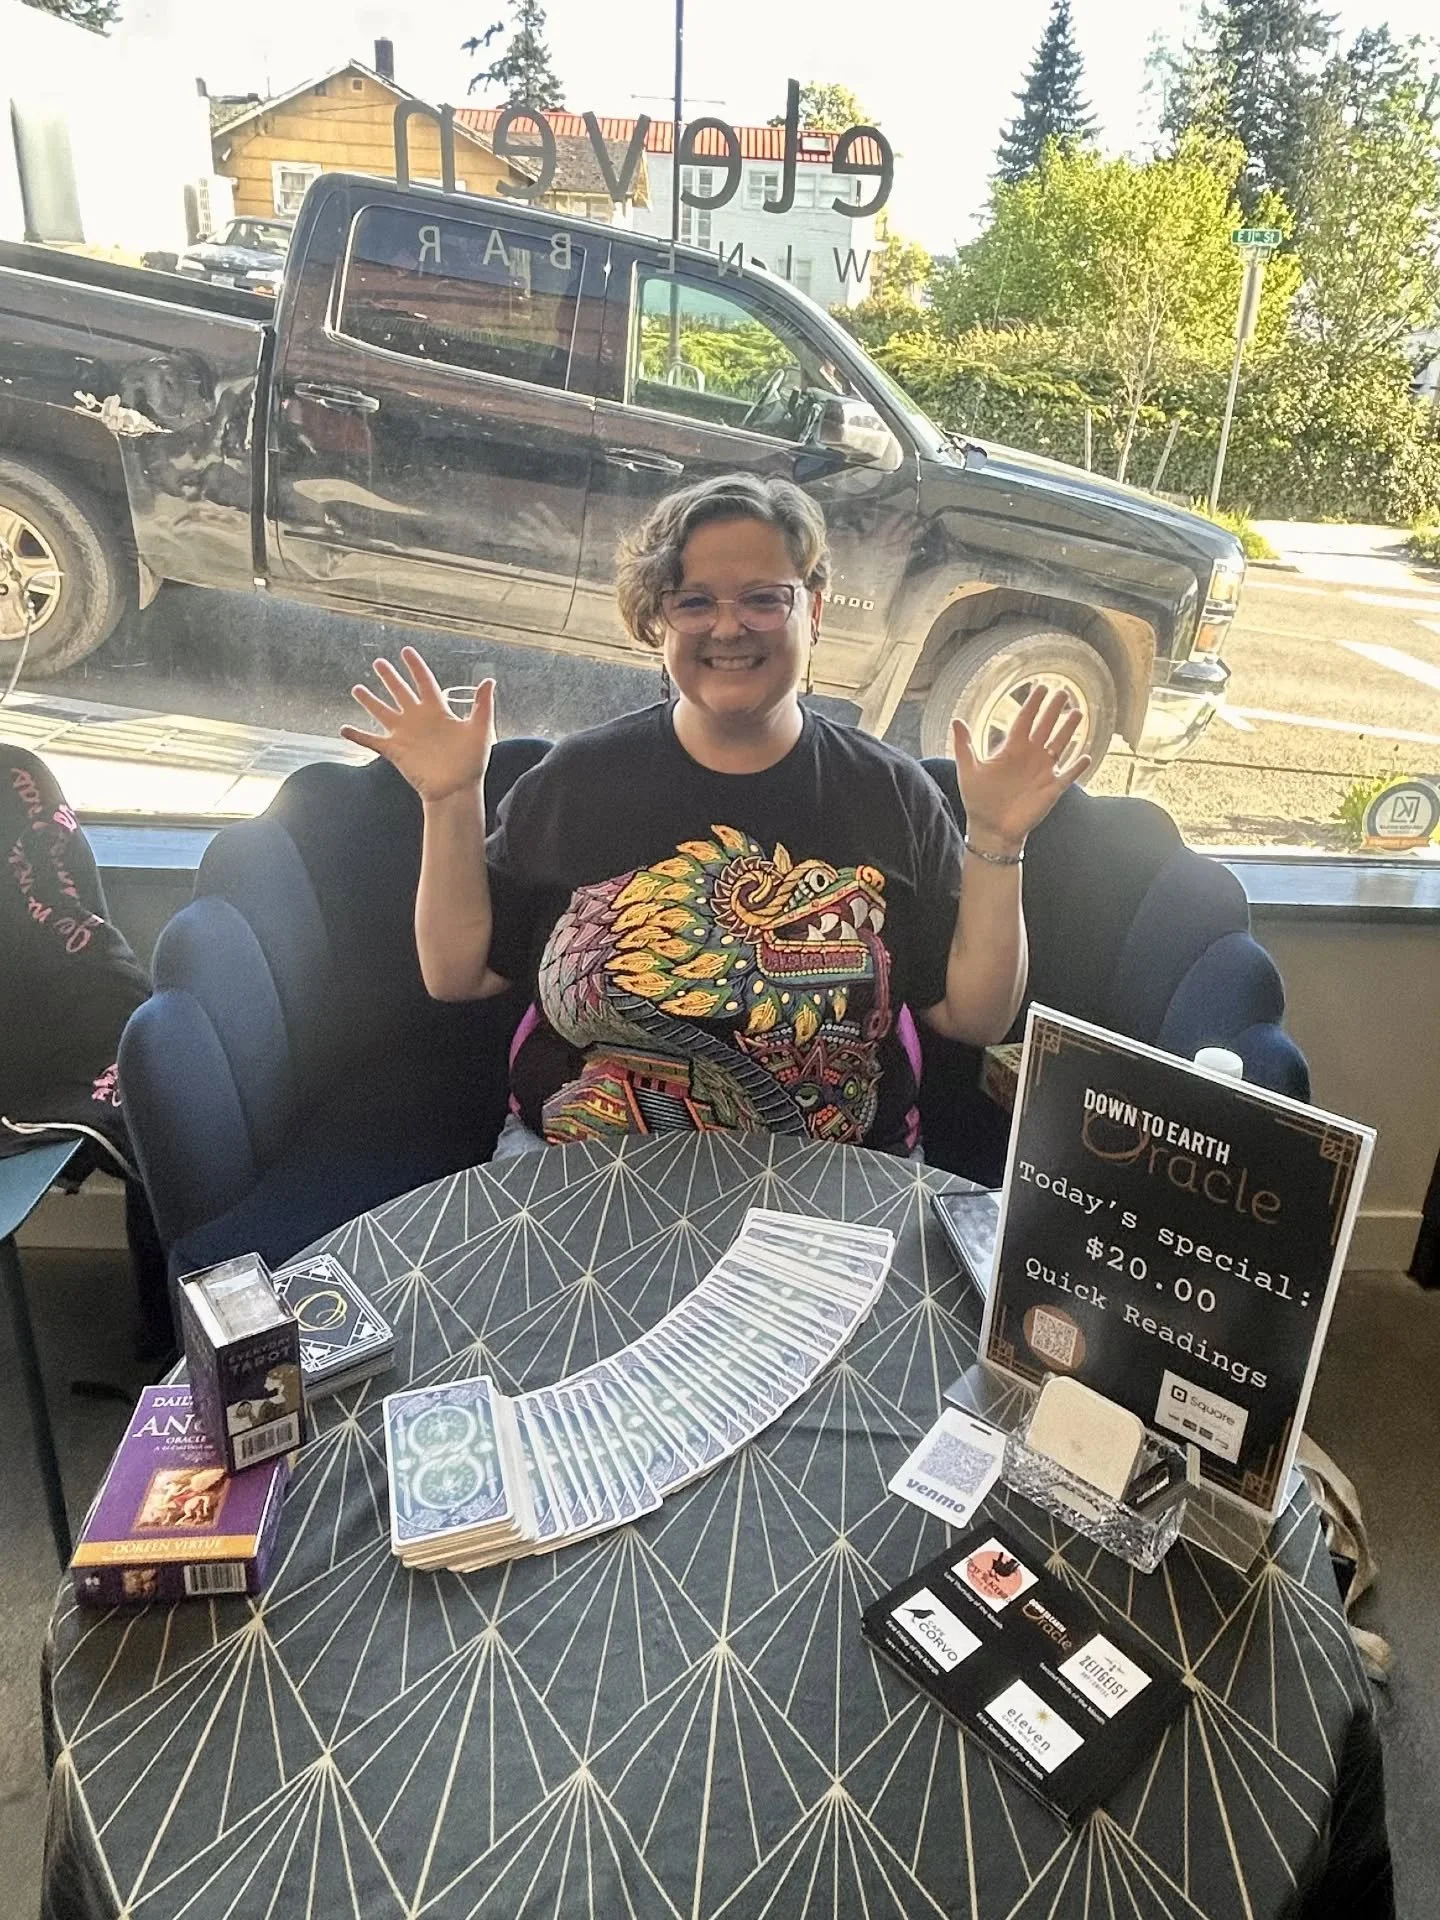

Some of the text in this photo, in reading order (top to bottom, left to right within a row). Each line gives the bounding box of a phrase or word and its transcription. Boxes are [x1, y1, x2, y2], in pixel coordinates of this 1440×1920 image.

[1237, 231, 1244, 242] E
[1083, 1088, 1231, 1165] DOWN TO EARTH
[1081, 1088, 1281, 1224] Oracle
[1018, 1160, 1311, 1307] Today's special:
[1085, 1236, 1217, 1313] $20.00
[1025, 1257, 1268, 1389] Quick Readings
[1190, 1395, 1235, 1426] Square
[906, 1478, 966, 1513] venmo
[918, 1622, 958, 1662] CORVO
[1022, 1602, 1072, 1650] Oracle
[1079, 1655, 1129, 1700] ZEITGEIST
[1007, 1708, 1051, 1751] eleven
